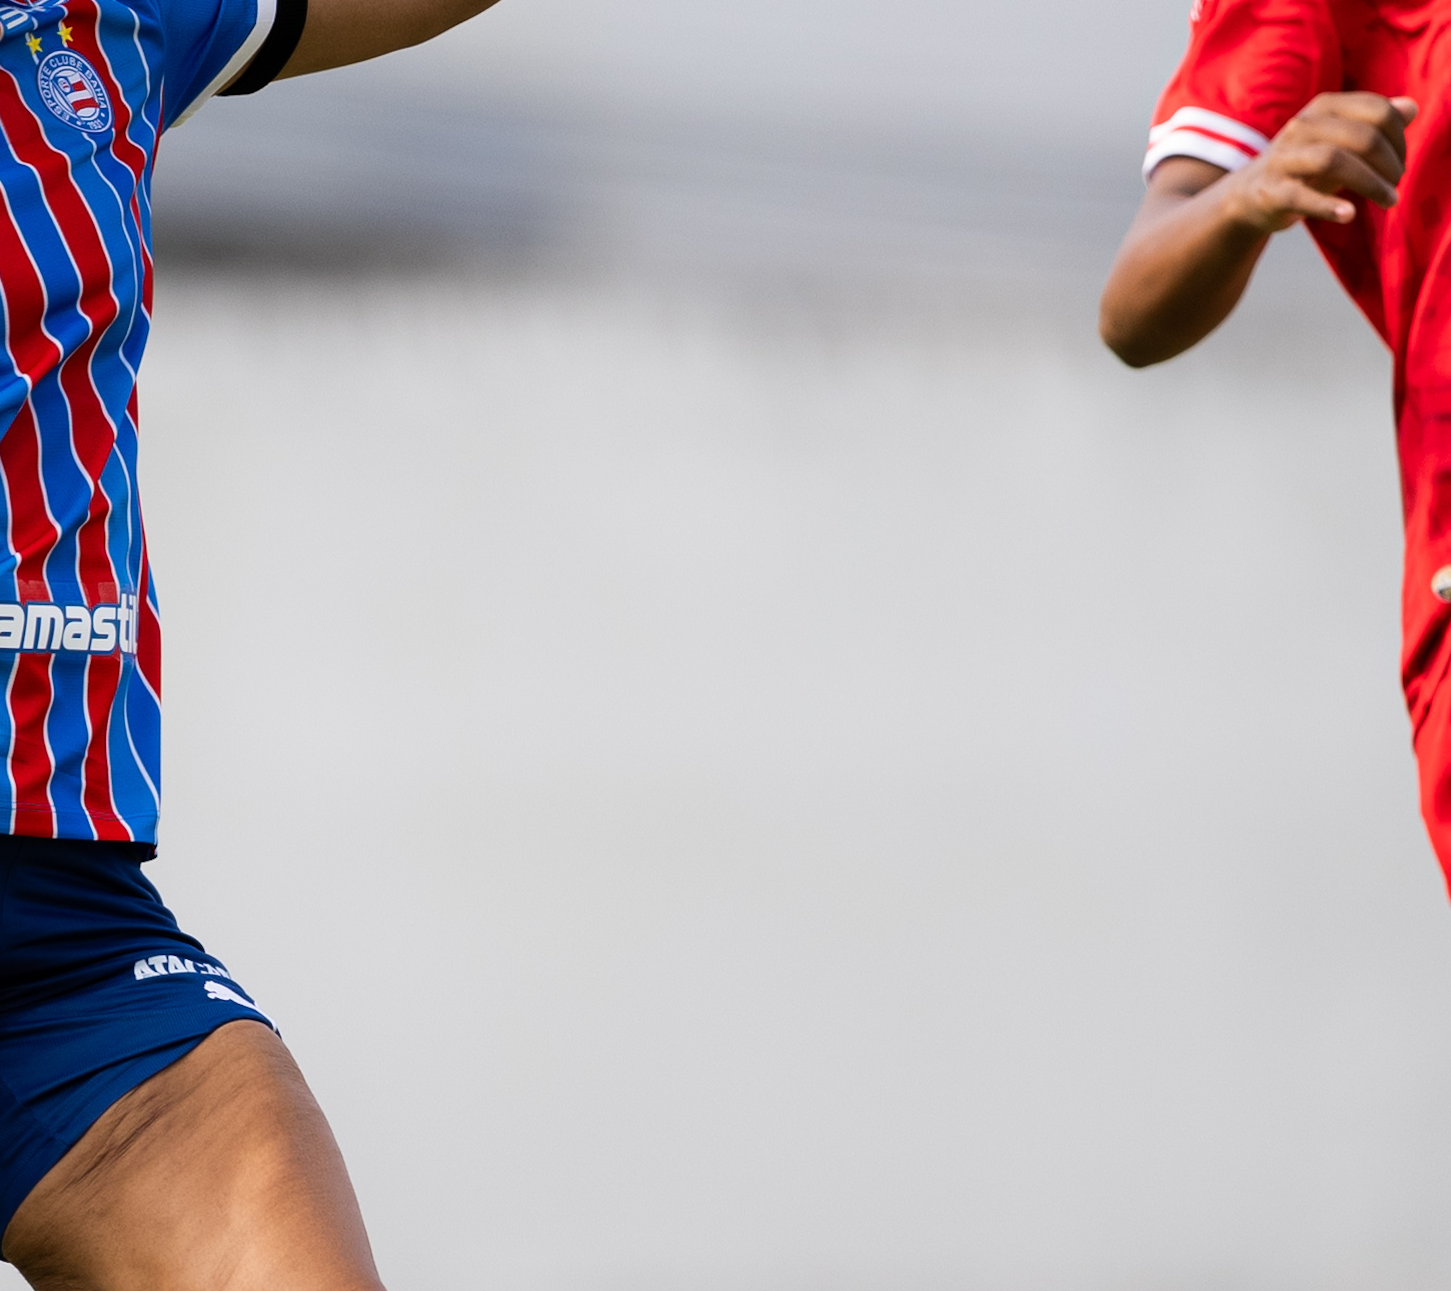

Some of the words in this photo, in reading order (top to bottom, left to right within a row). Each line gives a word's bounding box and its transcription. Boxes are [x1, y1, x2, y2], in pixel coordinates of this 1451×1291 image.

[48, 55, 84, 70] CLUBE
[41, 67, 71, 121] ESPORTE
[85, 70, 108, 109] BAHIA
